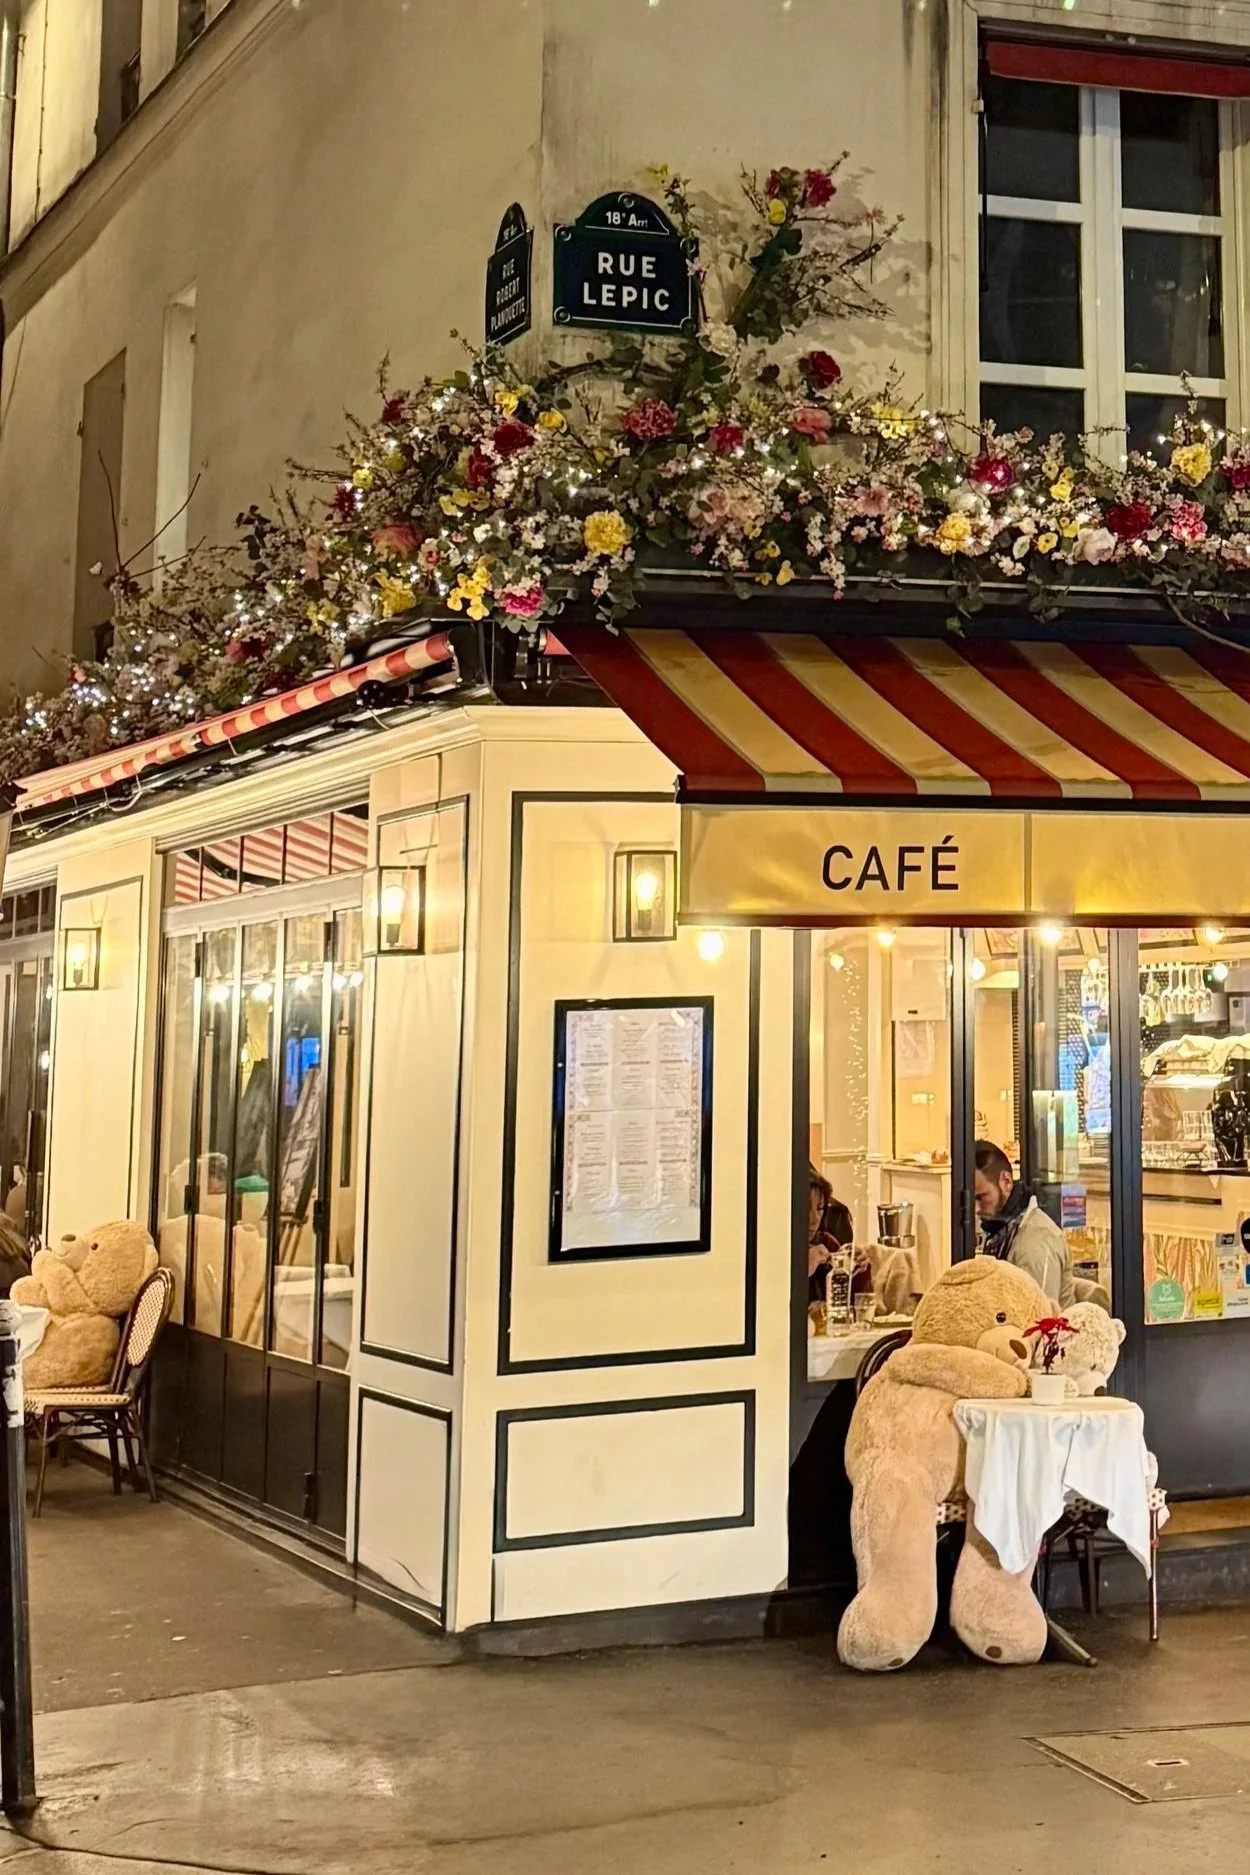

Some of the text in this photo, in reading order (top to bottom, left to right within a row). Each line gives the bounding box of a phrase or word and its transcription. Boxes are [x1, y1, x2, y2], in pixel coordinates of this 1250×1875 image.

[598, 252, 657, 279] RUE
[583, 282, 671, 312] LEPIC
[822, 835, 959, 891] CAFÉ
